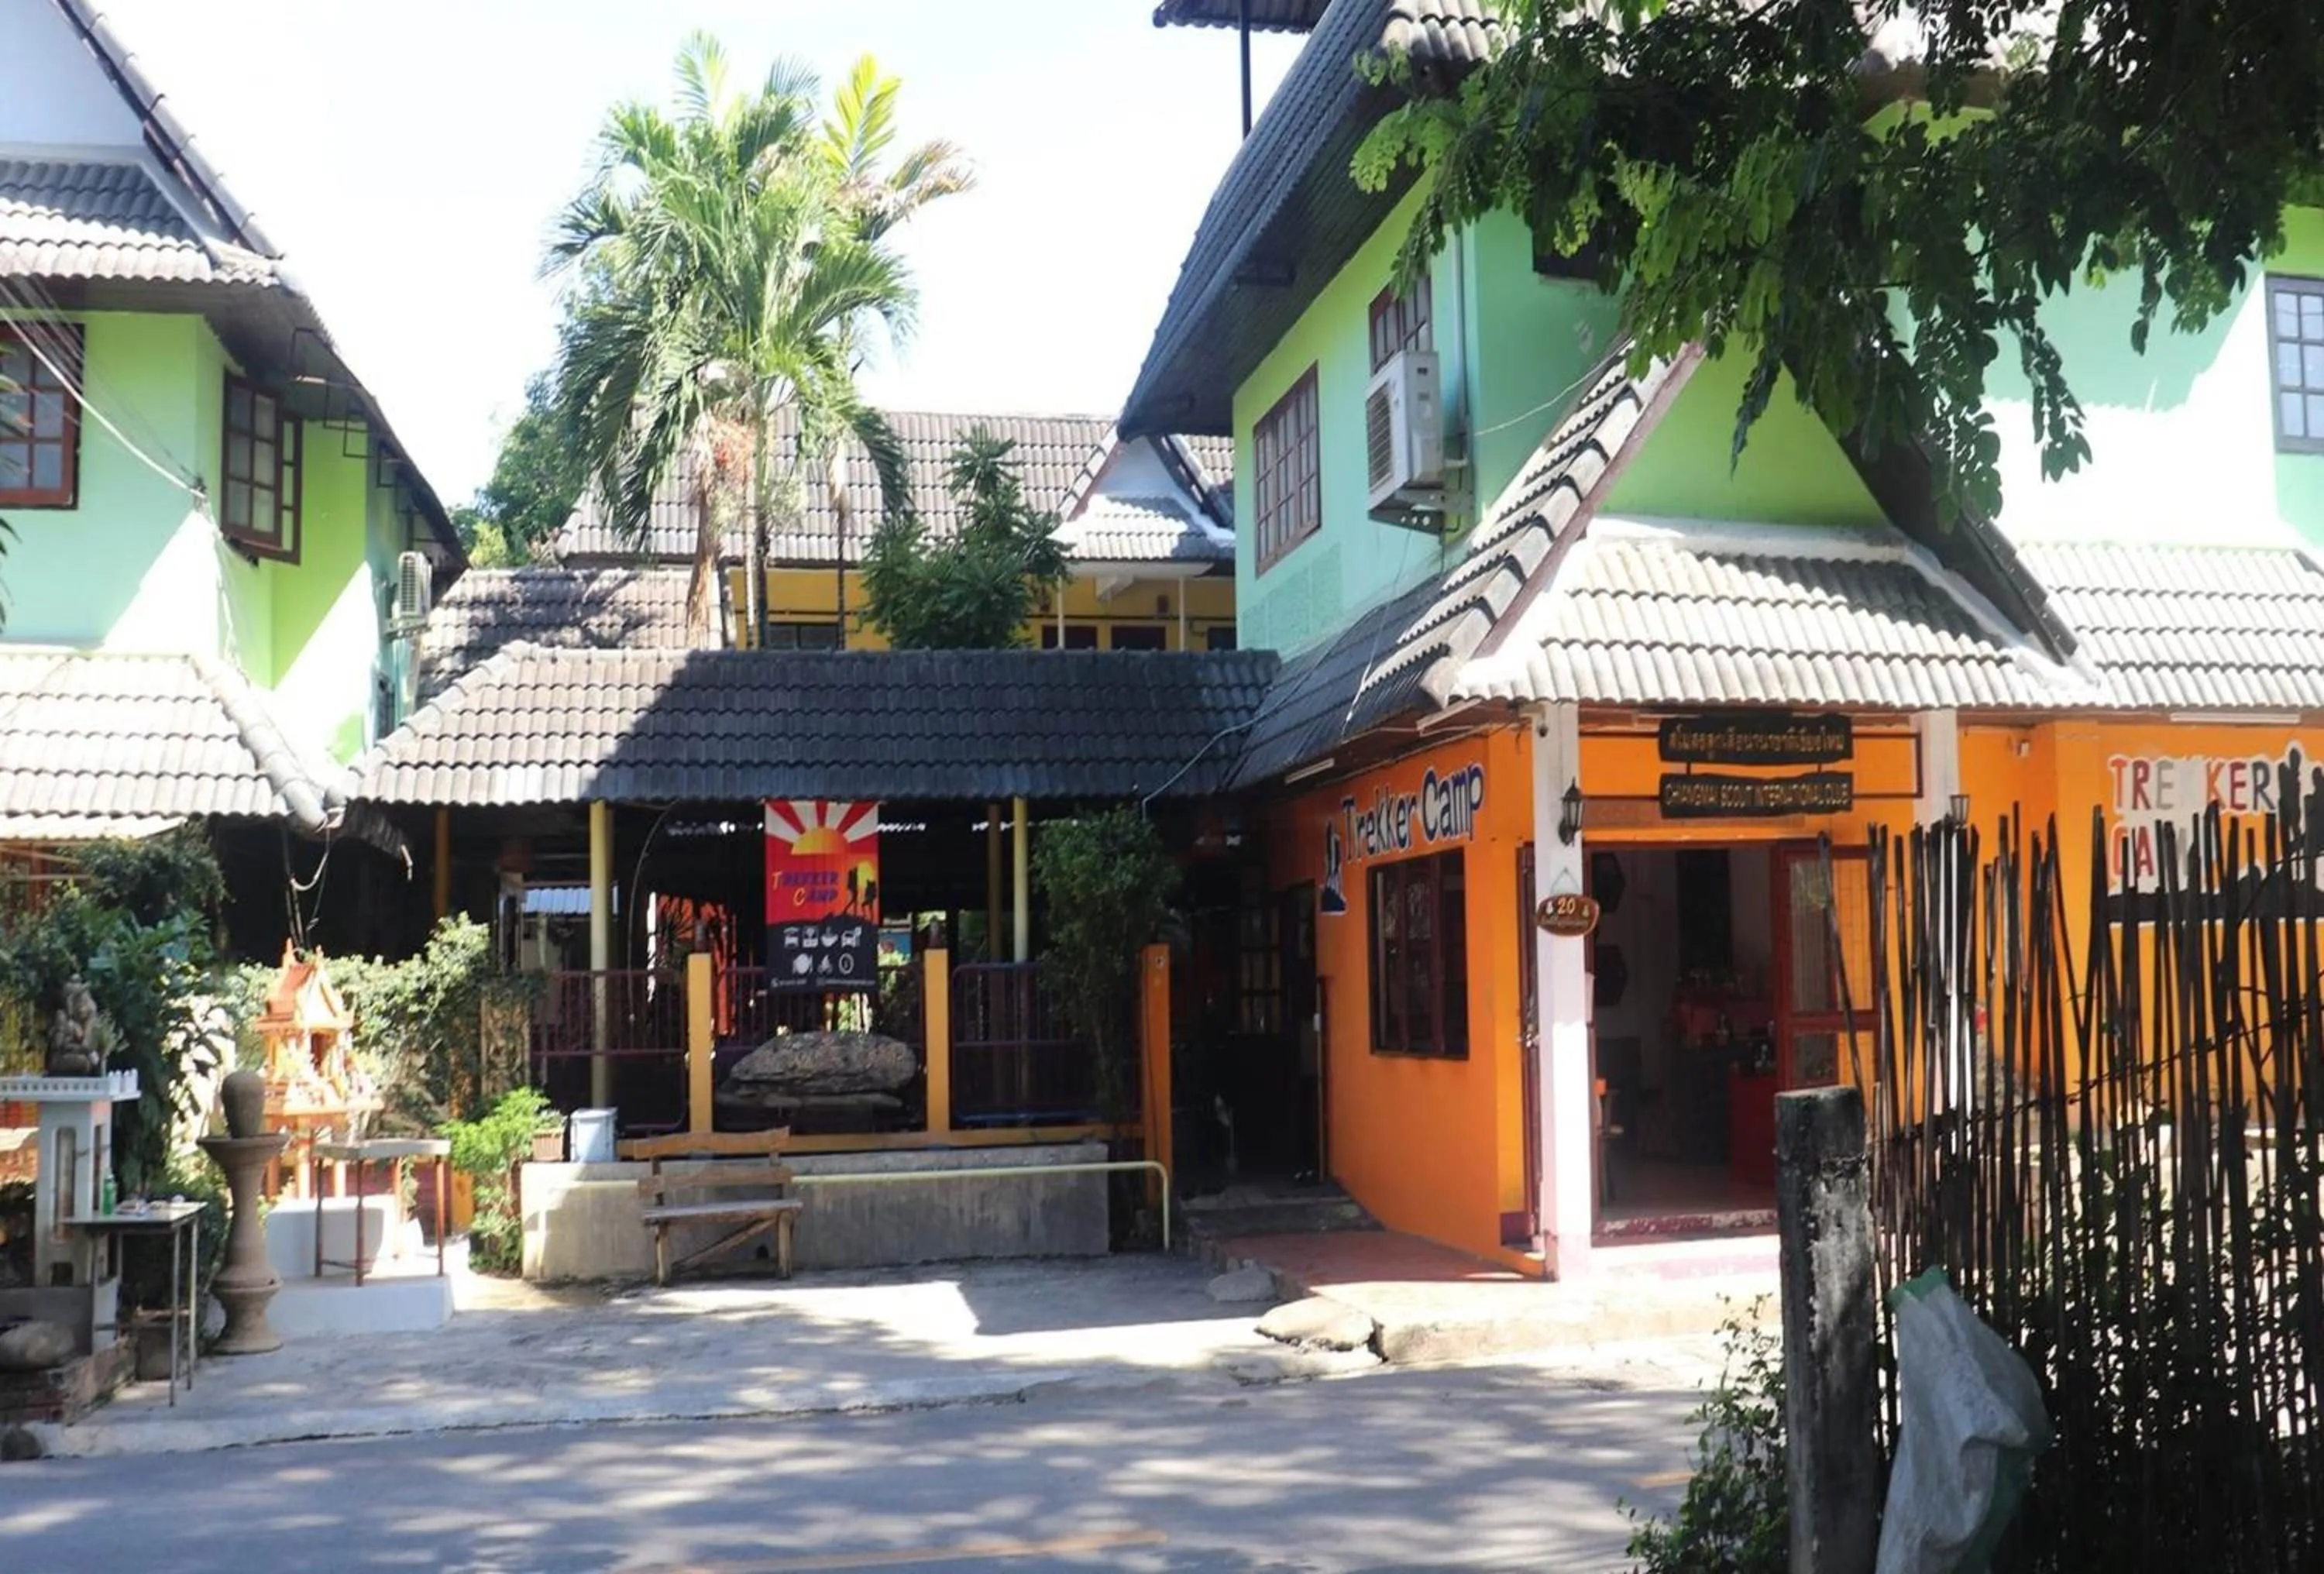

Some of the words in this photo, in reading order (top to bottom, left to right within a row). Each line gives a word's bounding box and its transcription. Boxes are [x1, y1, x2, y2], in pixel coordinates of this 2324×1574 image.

[2110, 758, 2276, 811] TREKER
[1340, 785, 1418, 863] Trekker
[1421, 761, 1487, 842] Camp
[1557, 898, 1576, 915] 20
